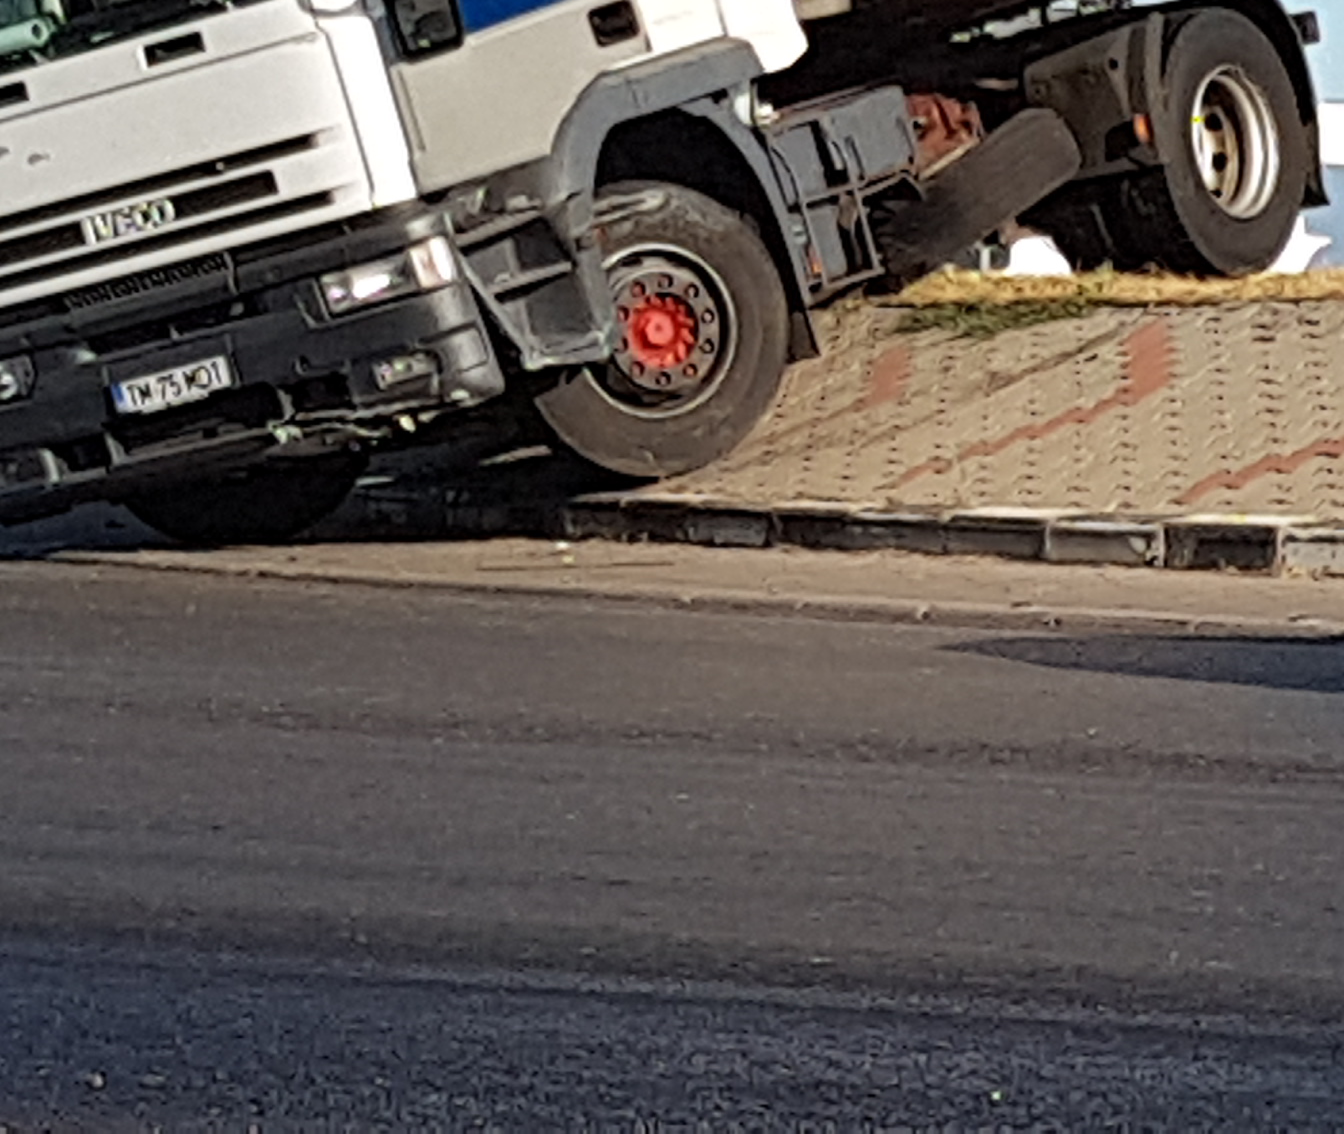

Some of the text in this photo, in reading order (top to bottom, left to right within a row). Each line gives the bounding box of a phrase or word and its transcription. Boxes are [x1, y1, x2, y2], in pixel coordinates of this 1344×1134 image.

[80, 197, 175, 245] IVECO
[126, 382, 152, 406] TM
[156, 373, 182, 400] 75
